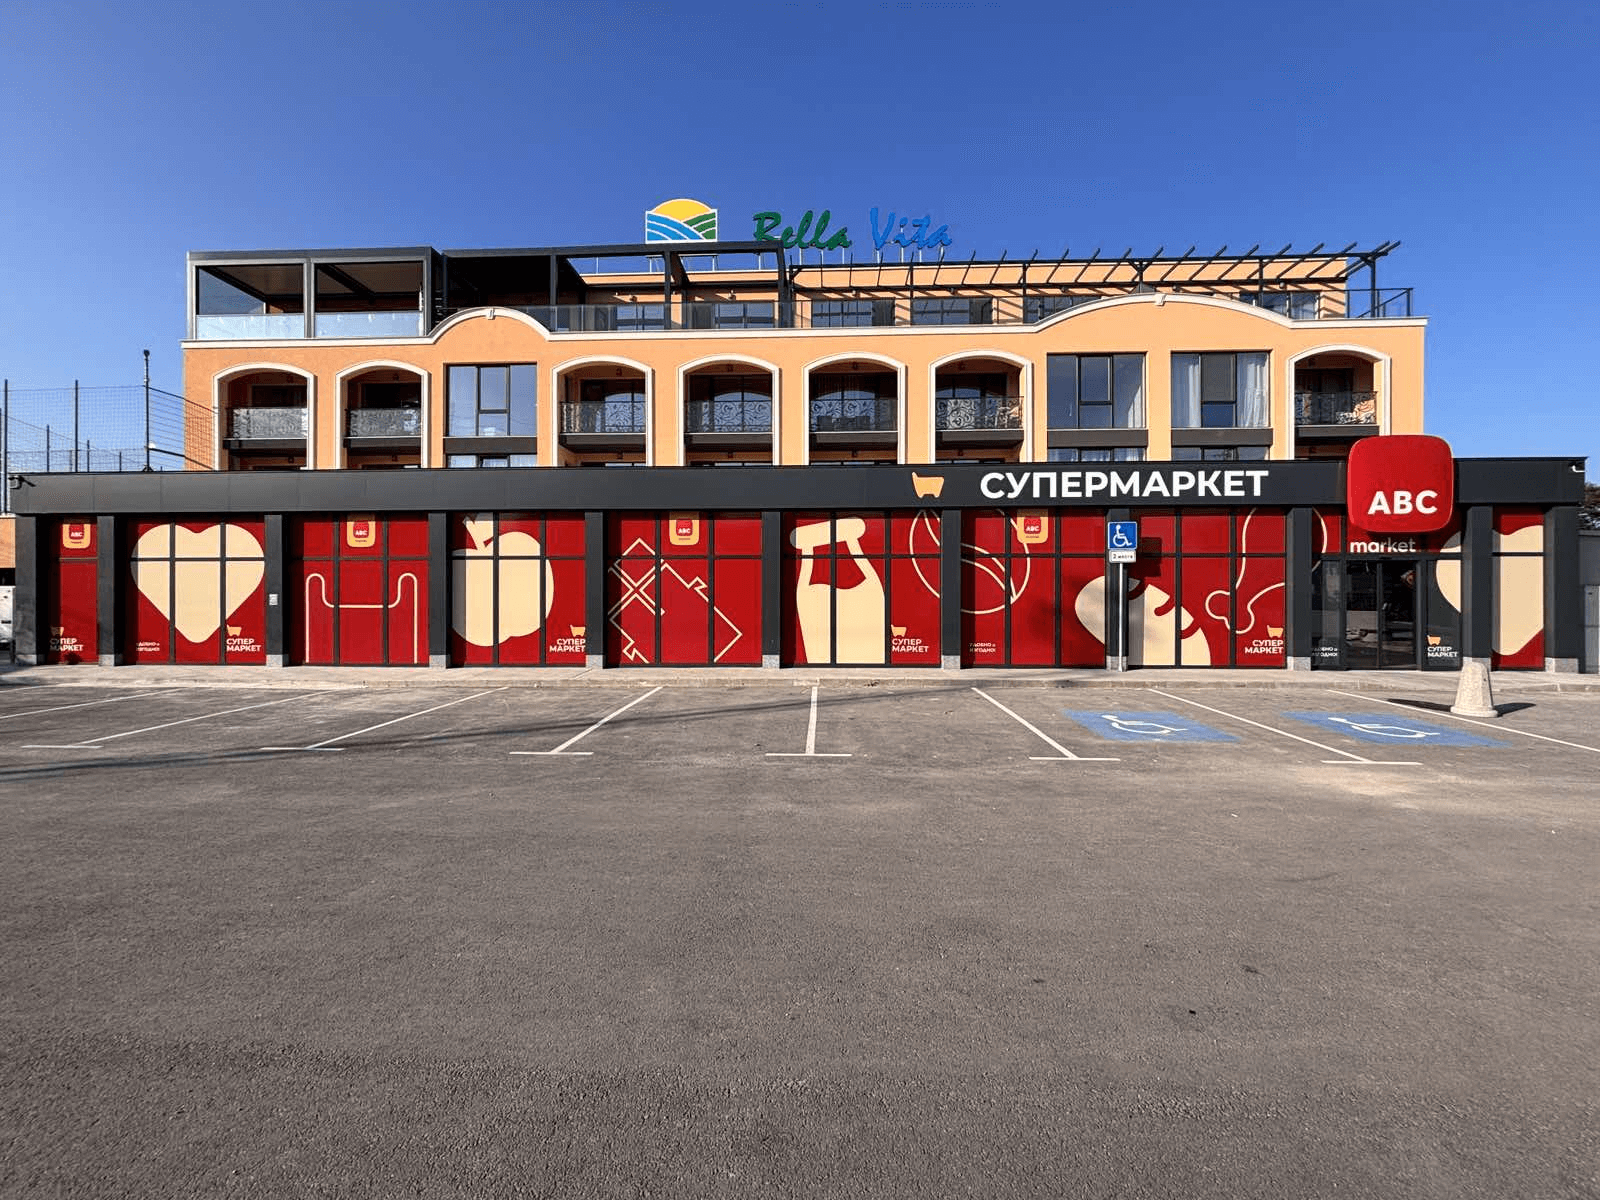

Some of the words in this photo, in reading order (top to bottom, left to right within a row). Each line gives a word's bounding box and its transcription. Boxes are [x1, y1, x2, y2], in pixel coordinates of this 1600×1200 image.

[753, 210, 853, 250] Rella
[869, 207, 953, 250] Vita
[979, 469, 1270, 501] СУПЕРМАРКЕТ
[1367, 489, 1439, 515] ABC
[1349, 537, 1416, 553] market
[556, 638, 586, 646] СУПЕР
[891, 638, 921, 646] СУПЕР
[1252, 639, 1283, 647] СУПЕР
[549, 645, 586, 653] МАРКЕТ
[891, 645, 929, 653] МАРКЕТ
[1244, 646, 1284, 654] МАРКЕТ
